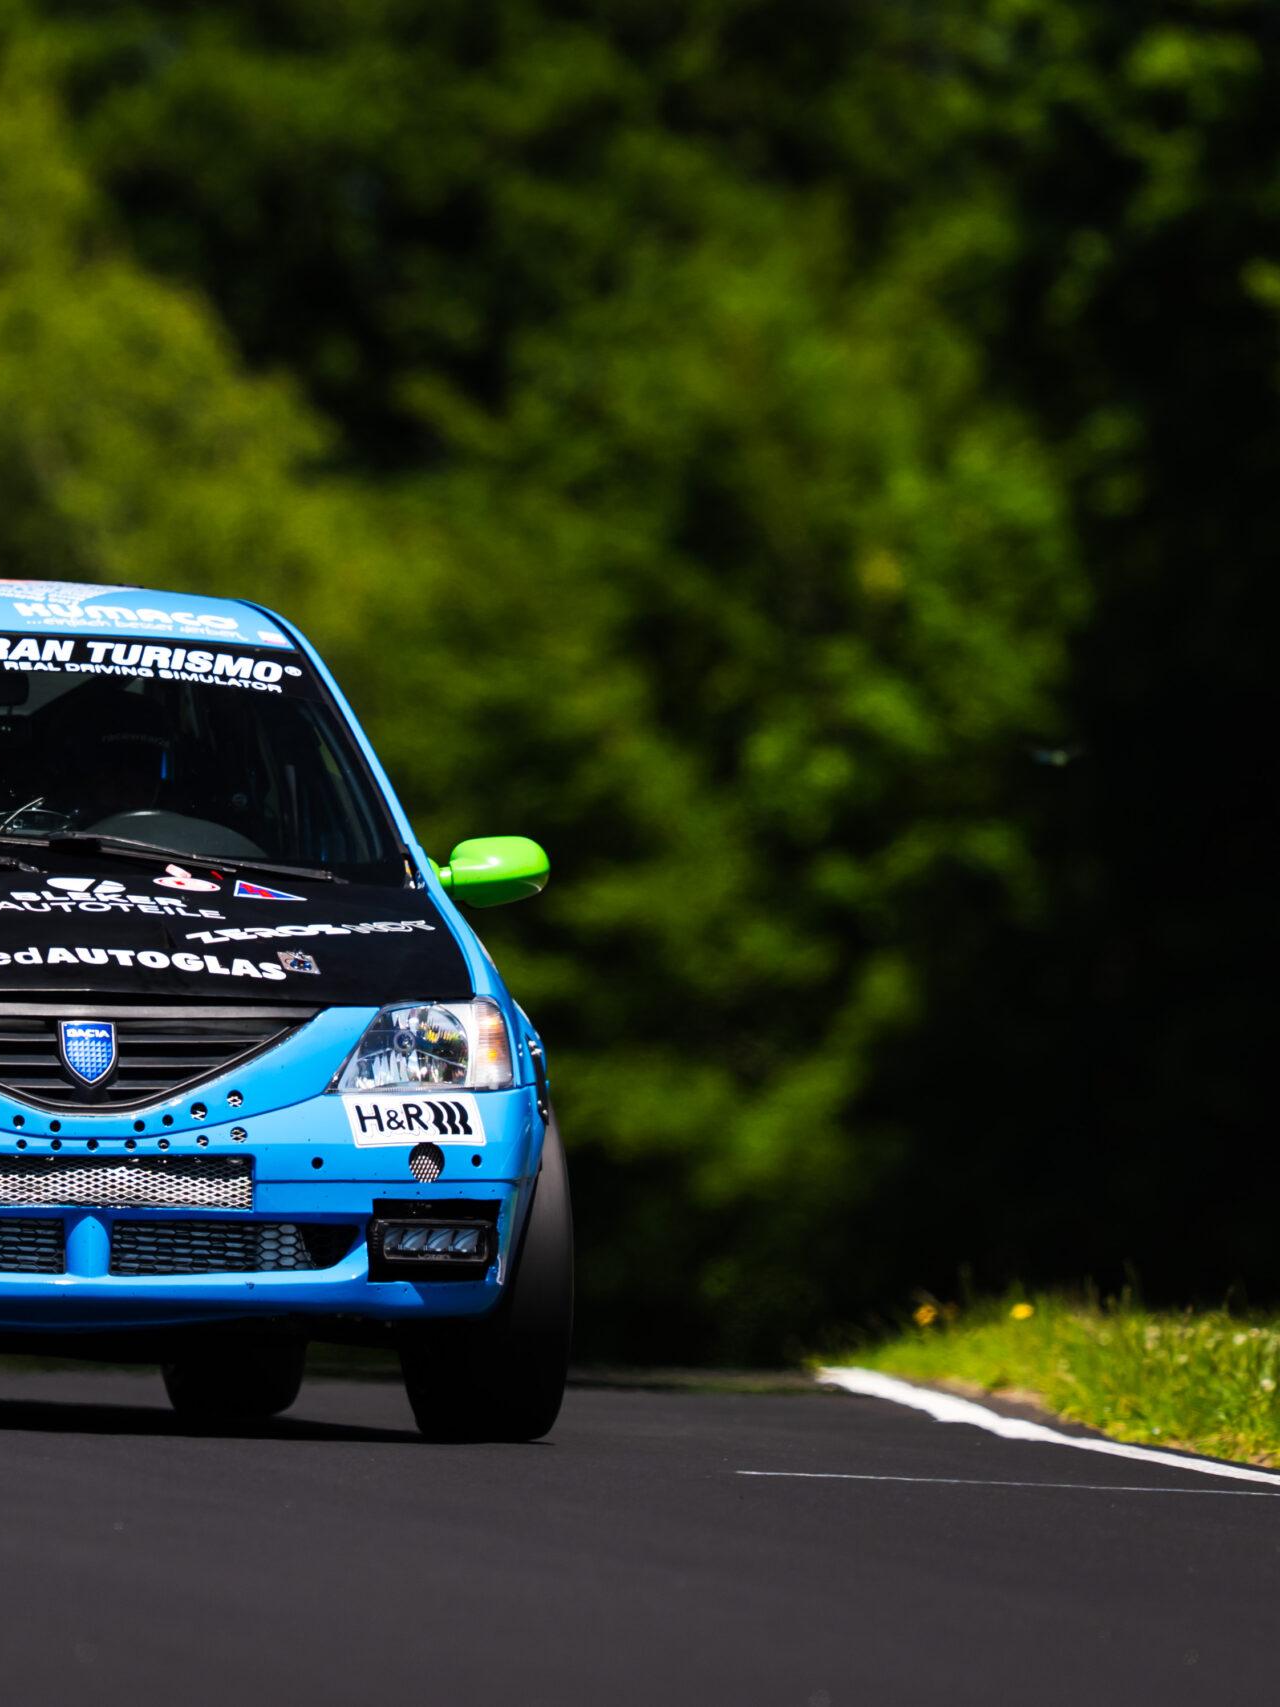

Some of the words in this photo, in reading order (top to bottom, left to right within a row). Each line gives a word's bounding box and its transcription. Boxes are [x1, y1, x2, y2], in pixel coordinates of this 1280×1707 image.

[4, 660, 61, 673] REAL
[65, 663, 154, 678] DRIVING
[158, 669, 283, 694] SIMULATOR
[10, 891, 188, 908] BLEKER
[66, 1028, 111, 1038] DACIA
[355, 1103, 429, 1133] H&R
